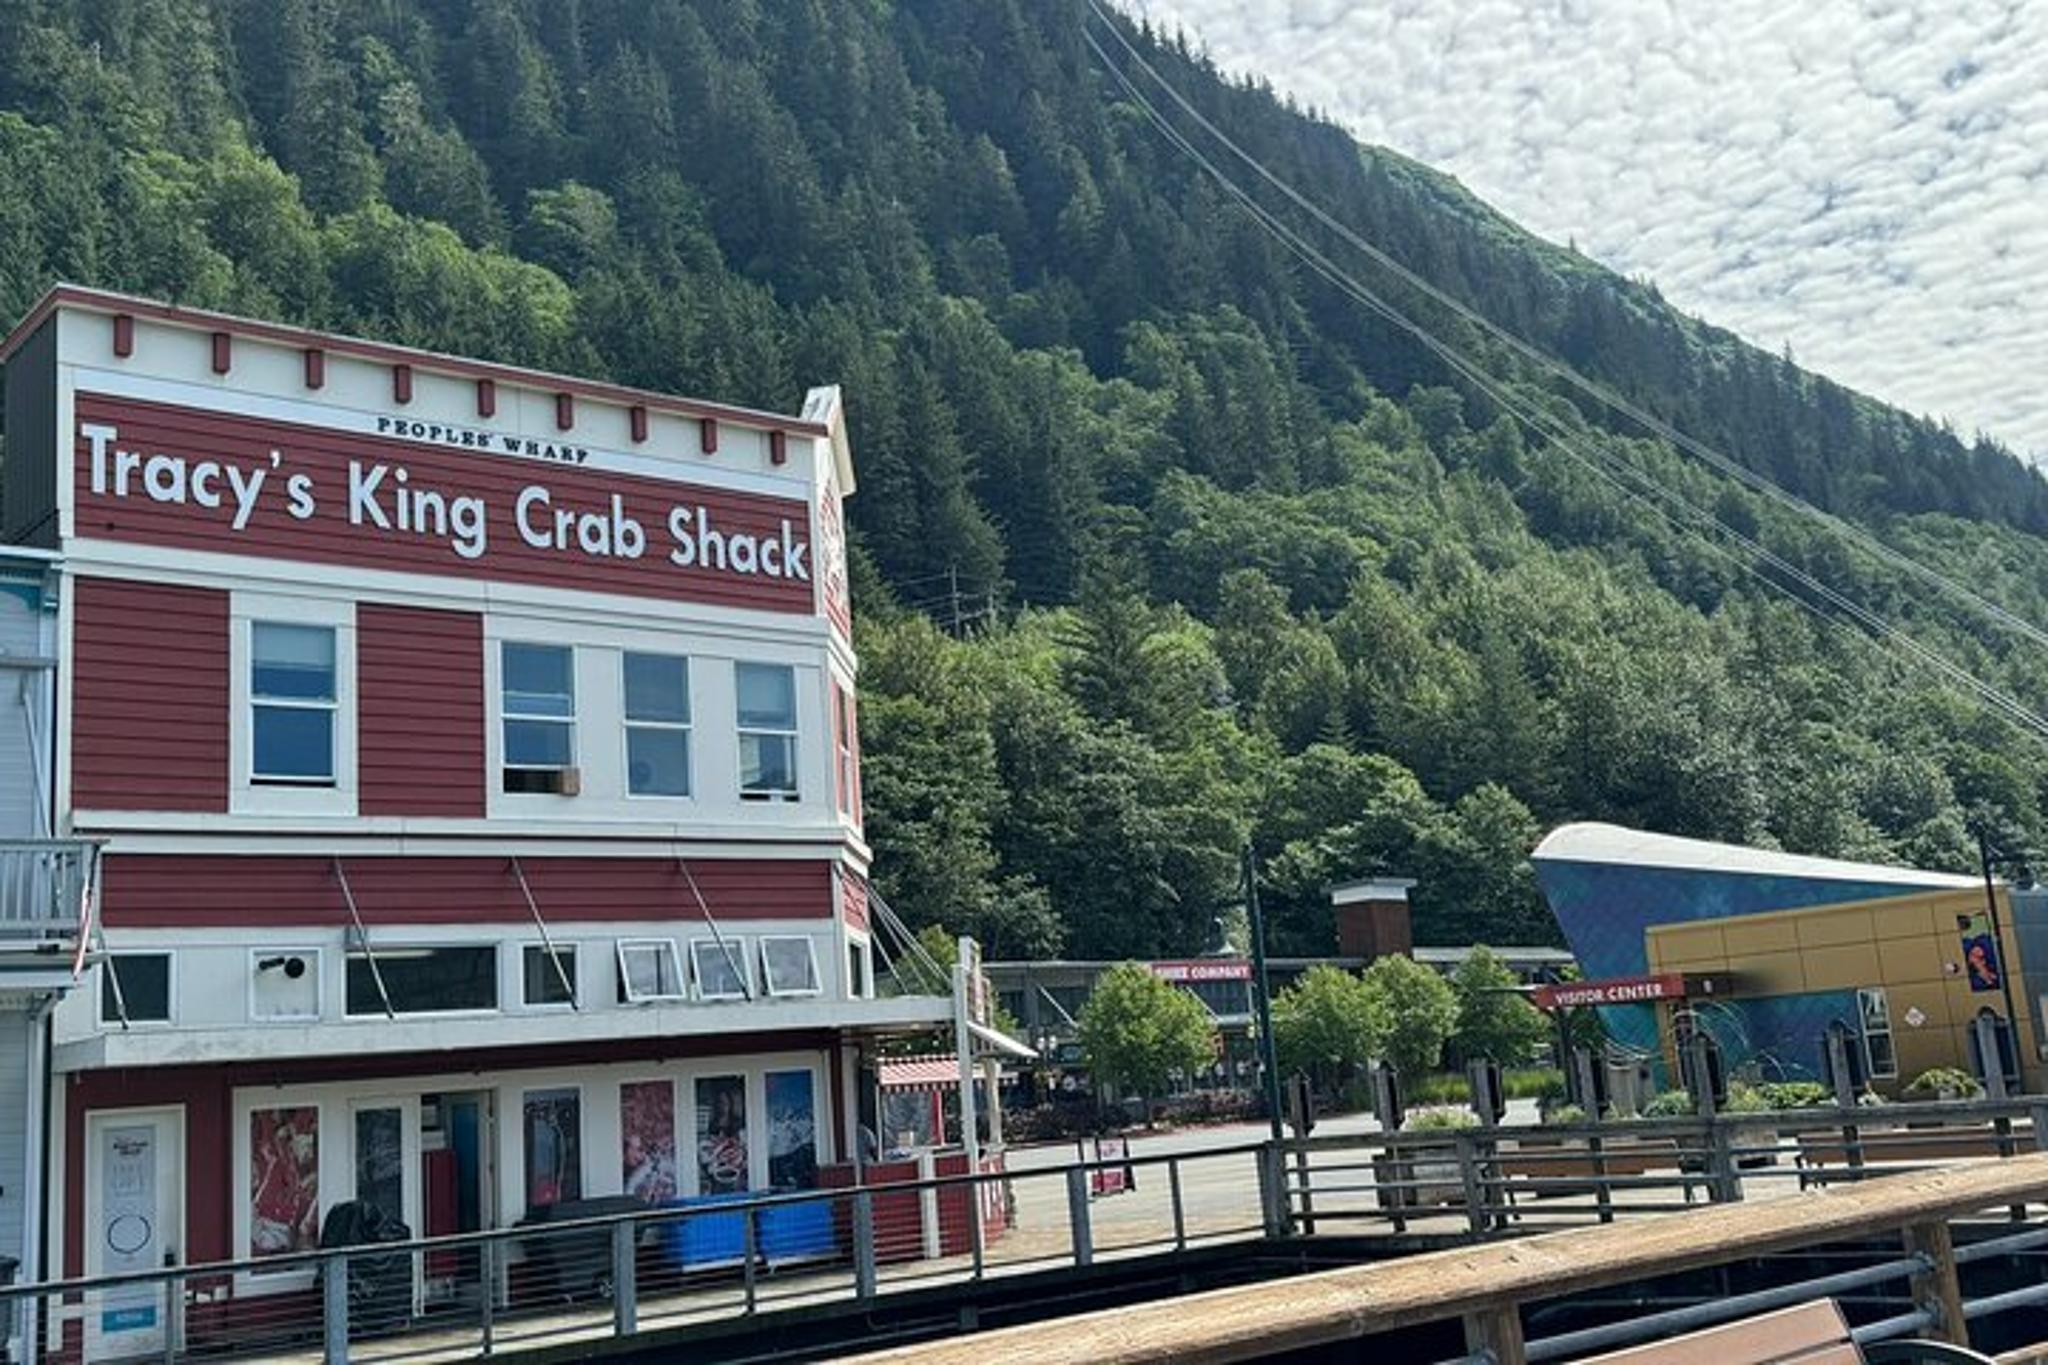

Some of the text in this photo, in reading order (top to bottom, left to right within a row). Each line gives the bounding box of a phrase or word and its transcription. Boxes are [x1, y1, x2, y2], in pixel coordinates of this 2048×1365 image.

[503, 437, 588, 464] WHARF
[81, 423, 314, 530] Tracy's
[349, 460, 486, 559] King
[516, 486, 646, 559] Crab
[669, 506, 810, 581] Shack
[1191, 966, 1248, 979] COMPANY
[1555, 982, 1663, 1004] VISITOR CENTER
